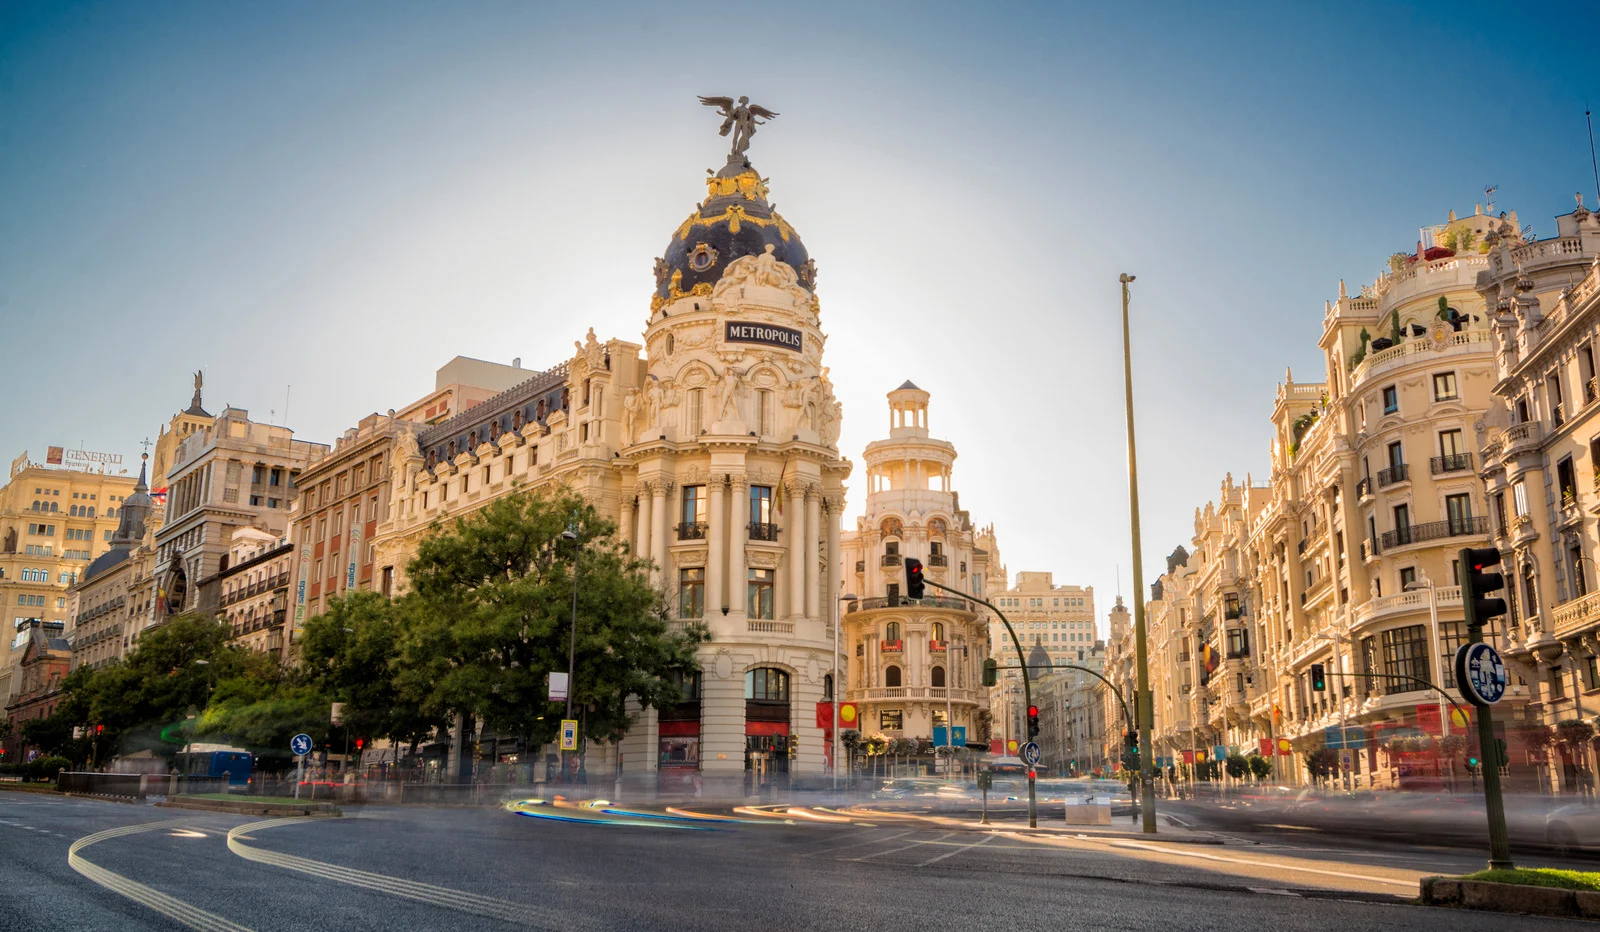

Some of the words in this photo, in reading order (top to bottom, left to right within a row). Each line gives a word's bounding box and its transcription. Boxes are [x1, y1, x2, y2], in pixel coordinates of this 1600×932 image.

[730, 326, 800, 346] METROPOLIS
[66, 449, 123, 465] GENERALI
[347, 562, 356, 588] salida
[297, 580, 306, 604] salida
[295, 605, 305, 620] hay
